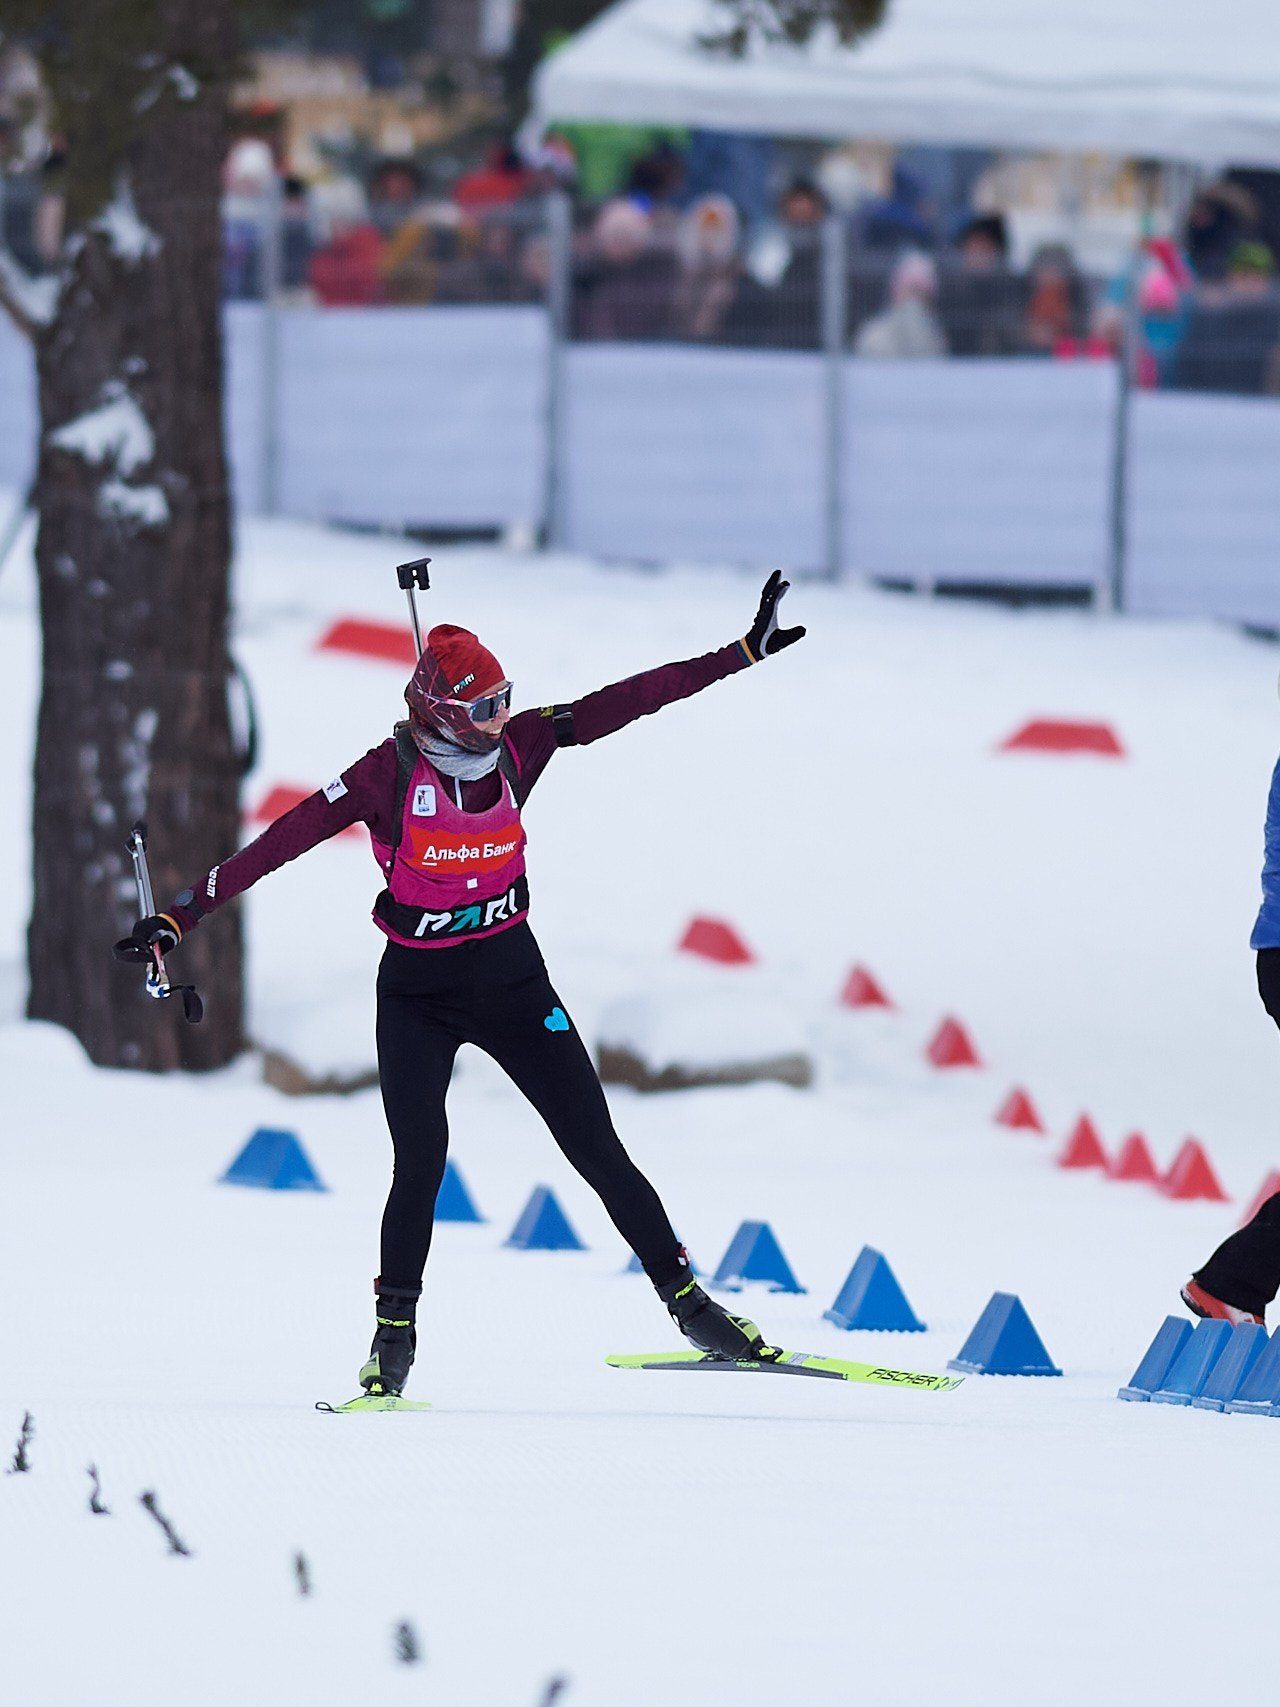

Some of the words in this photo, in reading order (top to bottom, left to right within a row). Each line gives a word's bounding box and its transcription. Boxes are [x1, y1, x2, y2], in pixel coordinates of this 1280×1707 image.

[422, 843, 480, 865] Альфа
[482, 841, 517, 859] Банк
[414, 887, 519, 937] PARI
[866, 1367, 939, 1387] FISCHER
